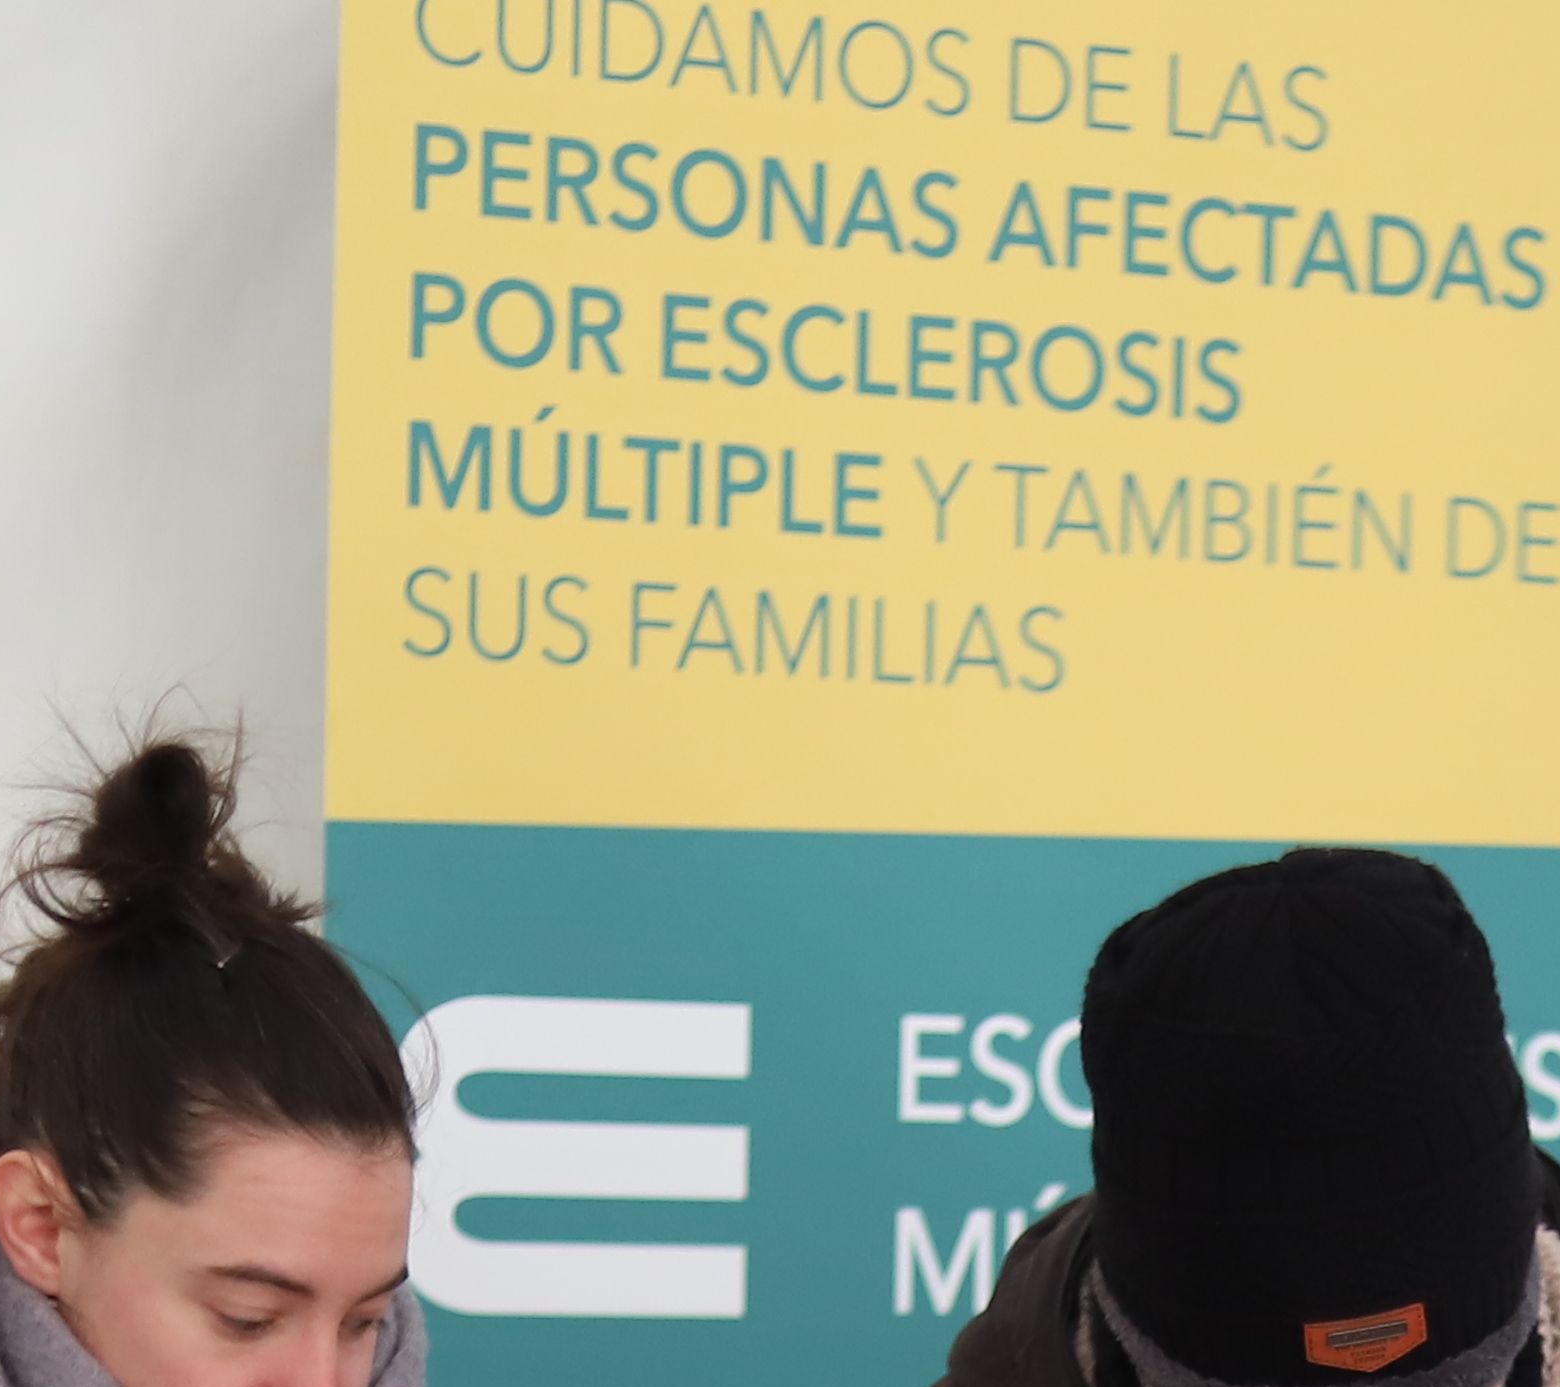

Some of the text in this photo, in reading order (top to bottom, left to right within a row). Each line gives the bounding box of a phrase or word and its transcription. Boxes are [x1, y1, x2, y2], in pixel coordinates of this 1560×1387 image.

[412, 0, 1331, 153] CUIDAMOS DE LAS
[412, 122, 1548, 312] PERSONAS AFECTADAS
[408, 271, 1244, 424] POR ESCLEROSIS
[406, 405, 884, 538] MÚLTIPLE
[911, 454, 970, 544] Y
[993, 462, 1413, 576] TAMBIÉN
[402, 567, 1069, 695] SUS FAMILIAS
